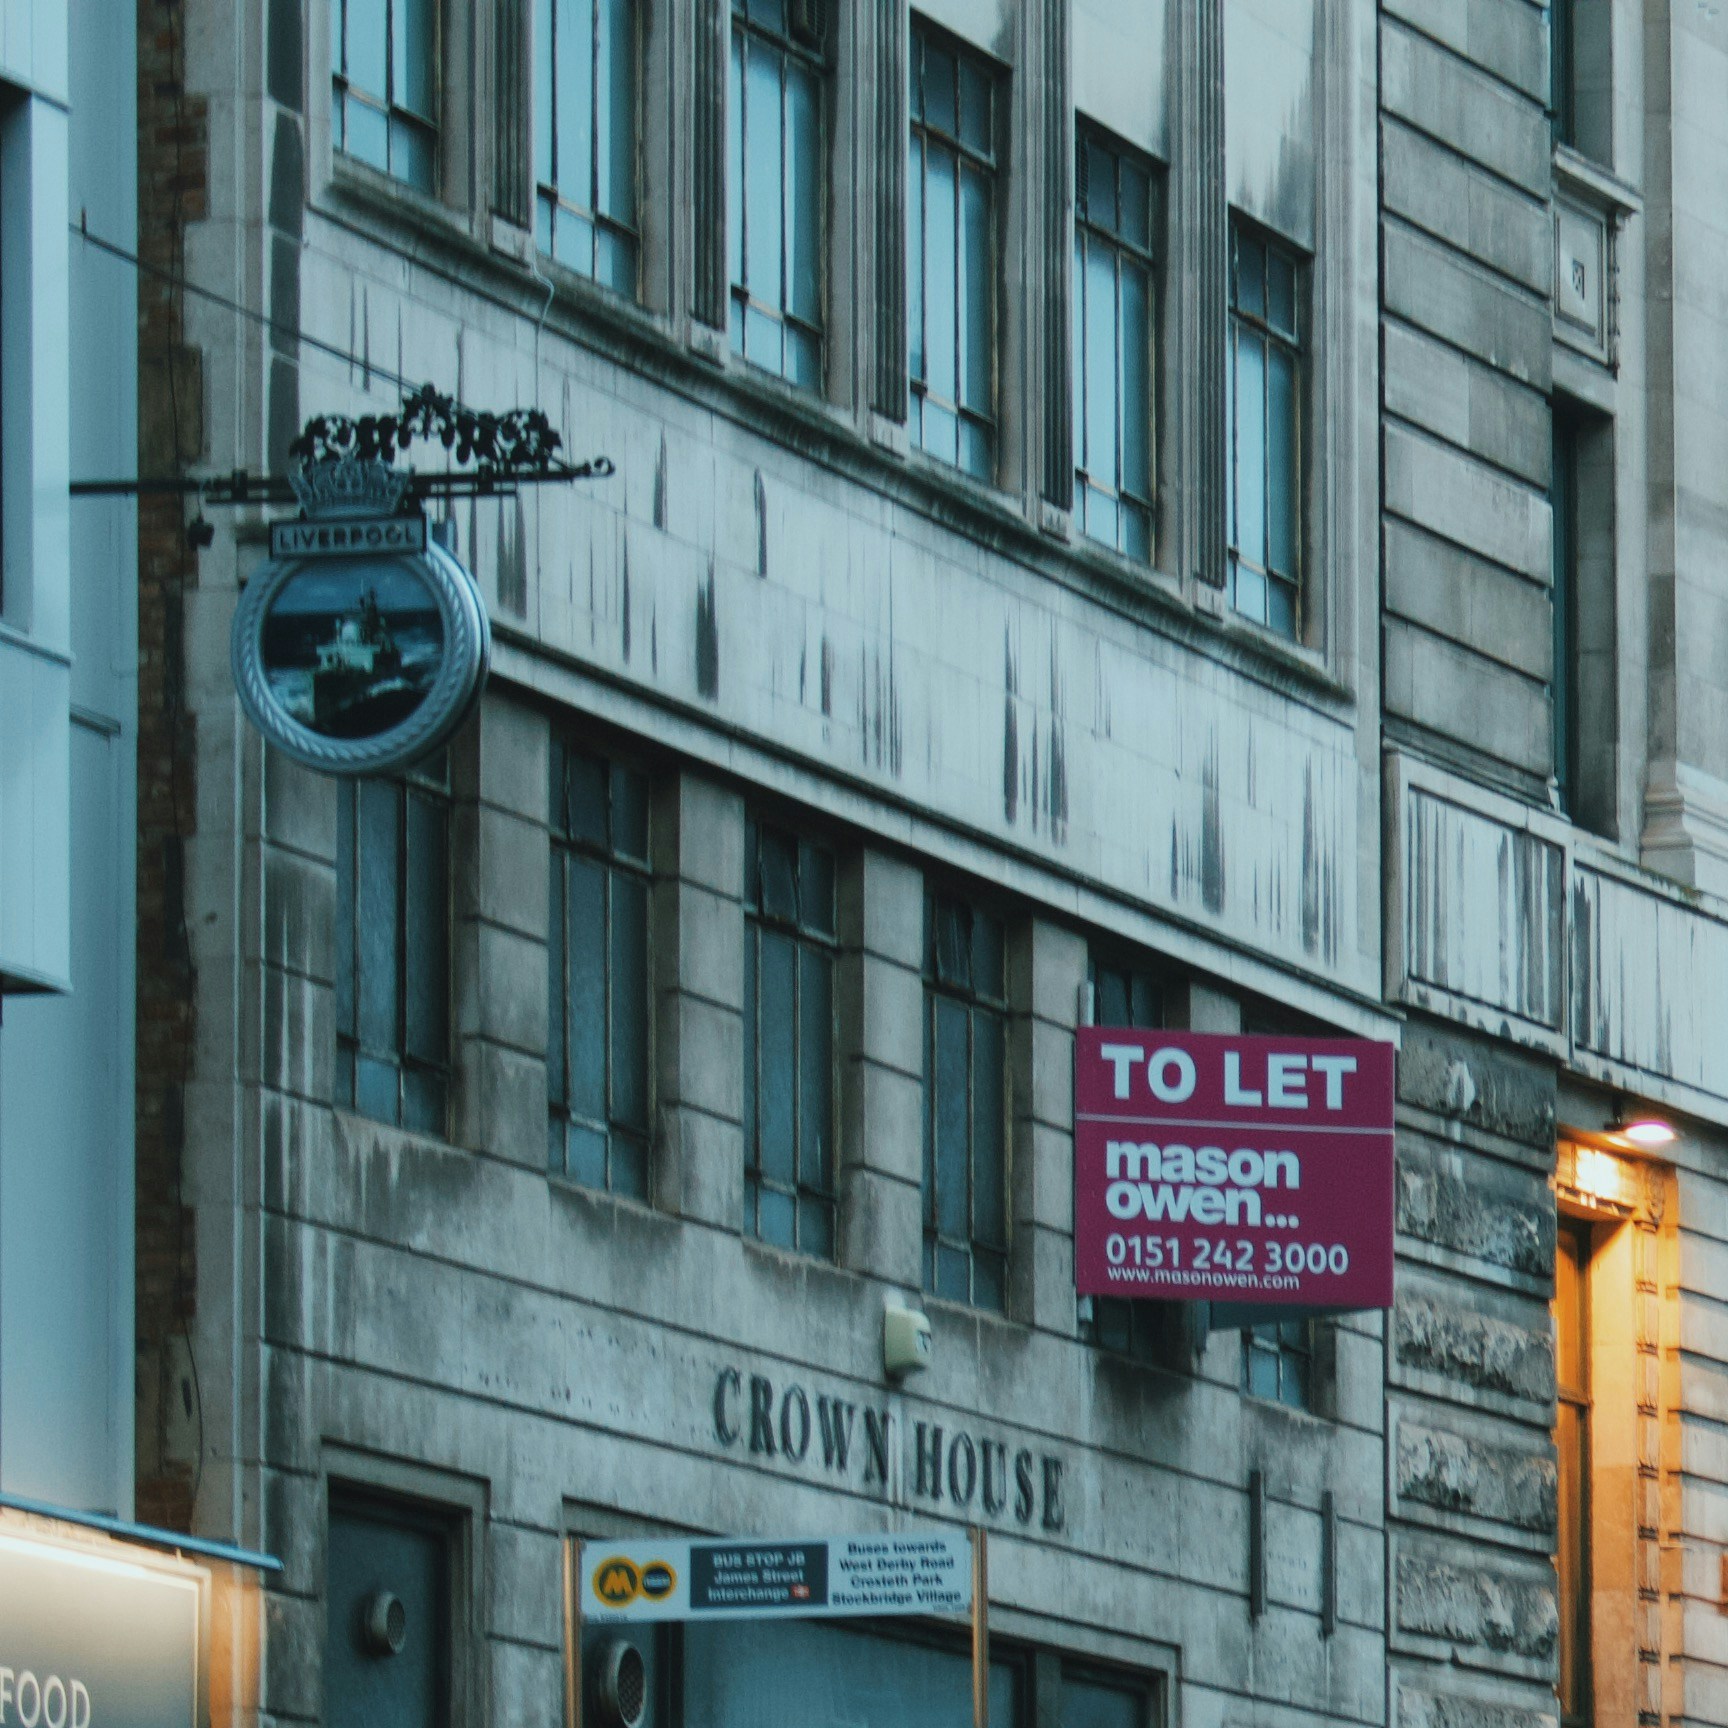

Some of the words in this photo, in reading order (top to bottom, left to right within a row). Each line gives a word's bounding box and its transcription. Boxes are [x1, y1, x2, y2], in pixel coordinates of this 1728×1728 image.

[280, 526, 416, 547] LIVERPOOL
[1101, 1043, 1196, 1103] TO
[1224, 1050, 1357, 1110] LET
[1106, 1140, 1300, 1189] mason
[1106, 1233, 1180, 1268] 0151
[1193, 1238, 1254, 1272] 242
[1265, 1241, 1348, 1275] 3000
[1107, 1266, 1299, 1290] www.masonowen.com
[713, 1366, 890, 1483] CROWN
[915, 1421, 1065, 1531] HOUSE
[848, 1542, 889, 1555] Buses
[893, 1540, 947, 1553] towards
[713, 1552, 741, 1568] BUS
[747, 1551, 784, 1567] STOP
[840, 1558, 872, 1571] West
[877, 1558, 916, 1571] Derby
[920, 1556, 955, 1569] Road
[714, 1571, 759, 1585] James
[763, 1569, 805, 1583] Street
[851, 1574, 909, 1588] Croxteth
[913, 1573, 943, 1587] Park
[708, 1586, 789, 1603] Interchange
[832, 1591, 913, 1606] Stockbridge
[916, 1589, 961, 1603] Village
